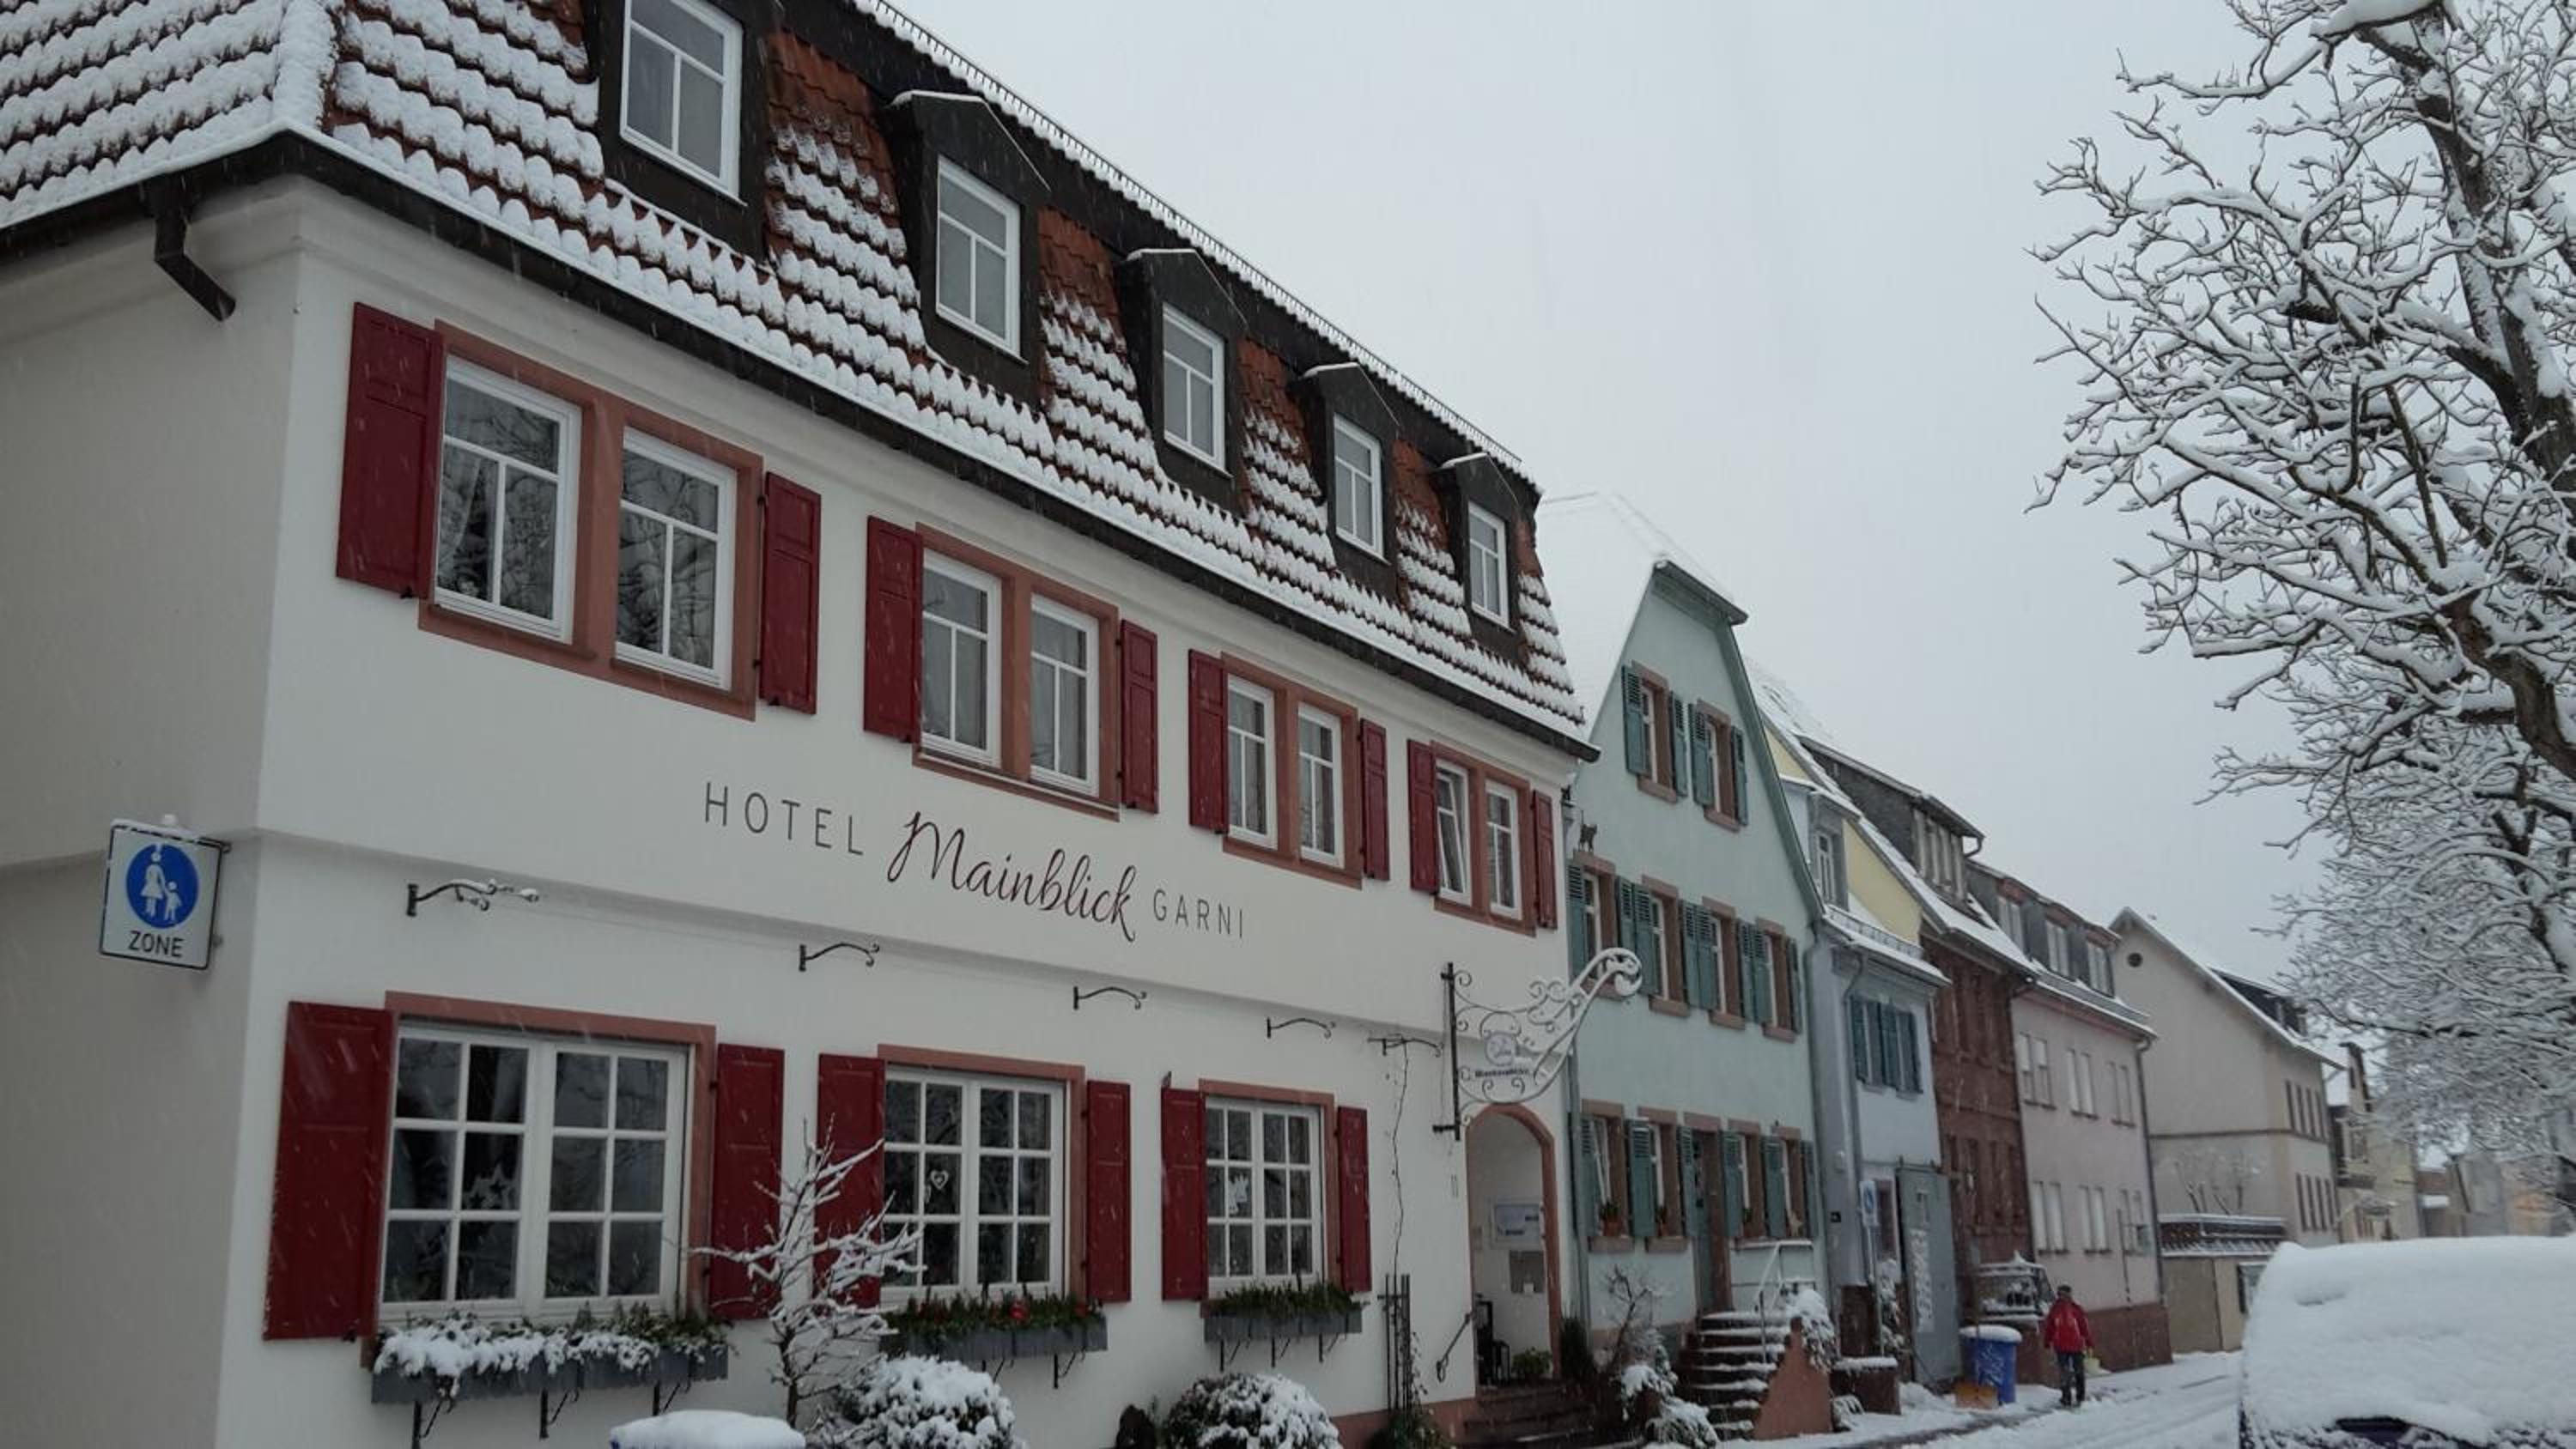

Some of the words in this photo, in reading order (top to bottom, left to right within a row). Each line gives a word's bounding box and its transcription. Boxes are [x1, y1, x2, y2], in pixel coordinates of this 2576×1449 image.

[704, 781, 864, 856] HOTEL
[887, 810, 1135, 943] Mainblick
[1152, 889, 1243, 939] GARNI
[129, 931, 185, 958] ZONE
